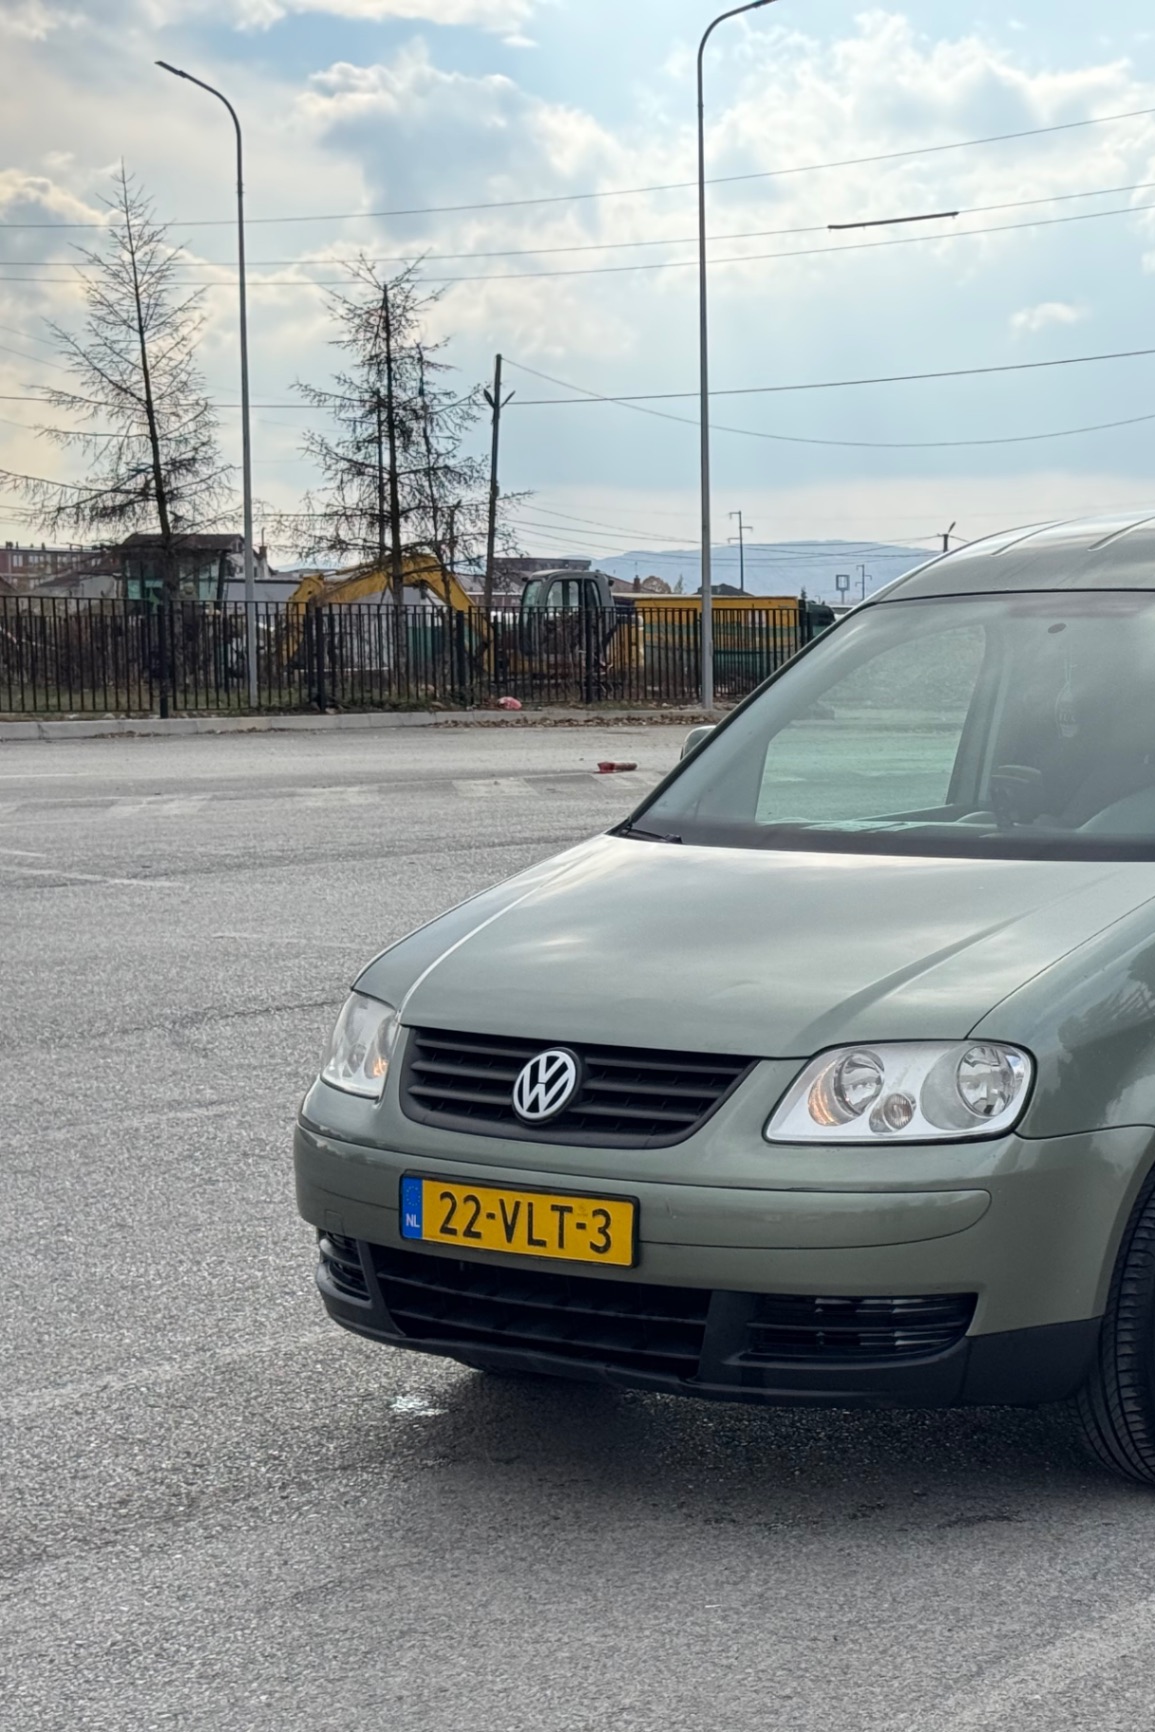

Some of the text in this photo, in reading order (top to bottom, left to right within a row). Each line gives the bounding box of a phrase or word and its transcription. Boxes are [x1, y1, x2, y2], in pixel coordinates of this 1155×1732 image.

[517, 1053, 572, 1116] VW
[405, 1213, 420, 1229] NL
[439, 1191, 612, 1254] 22-VLT-3
